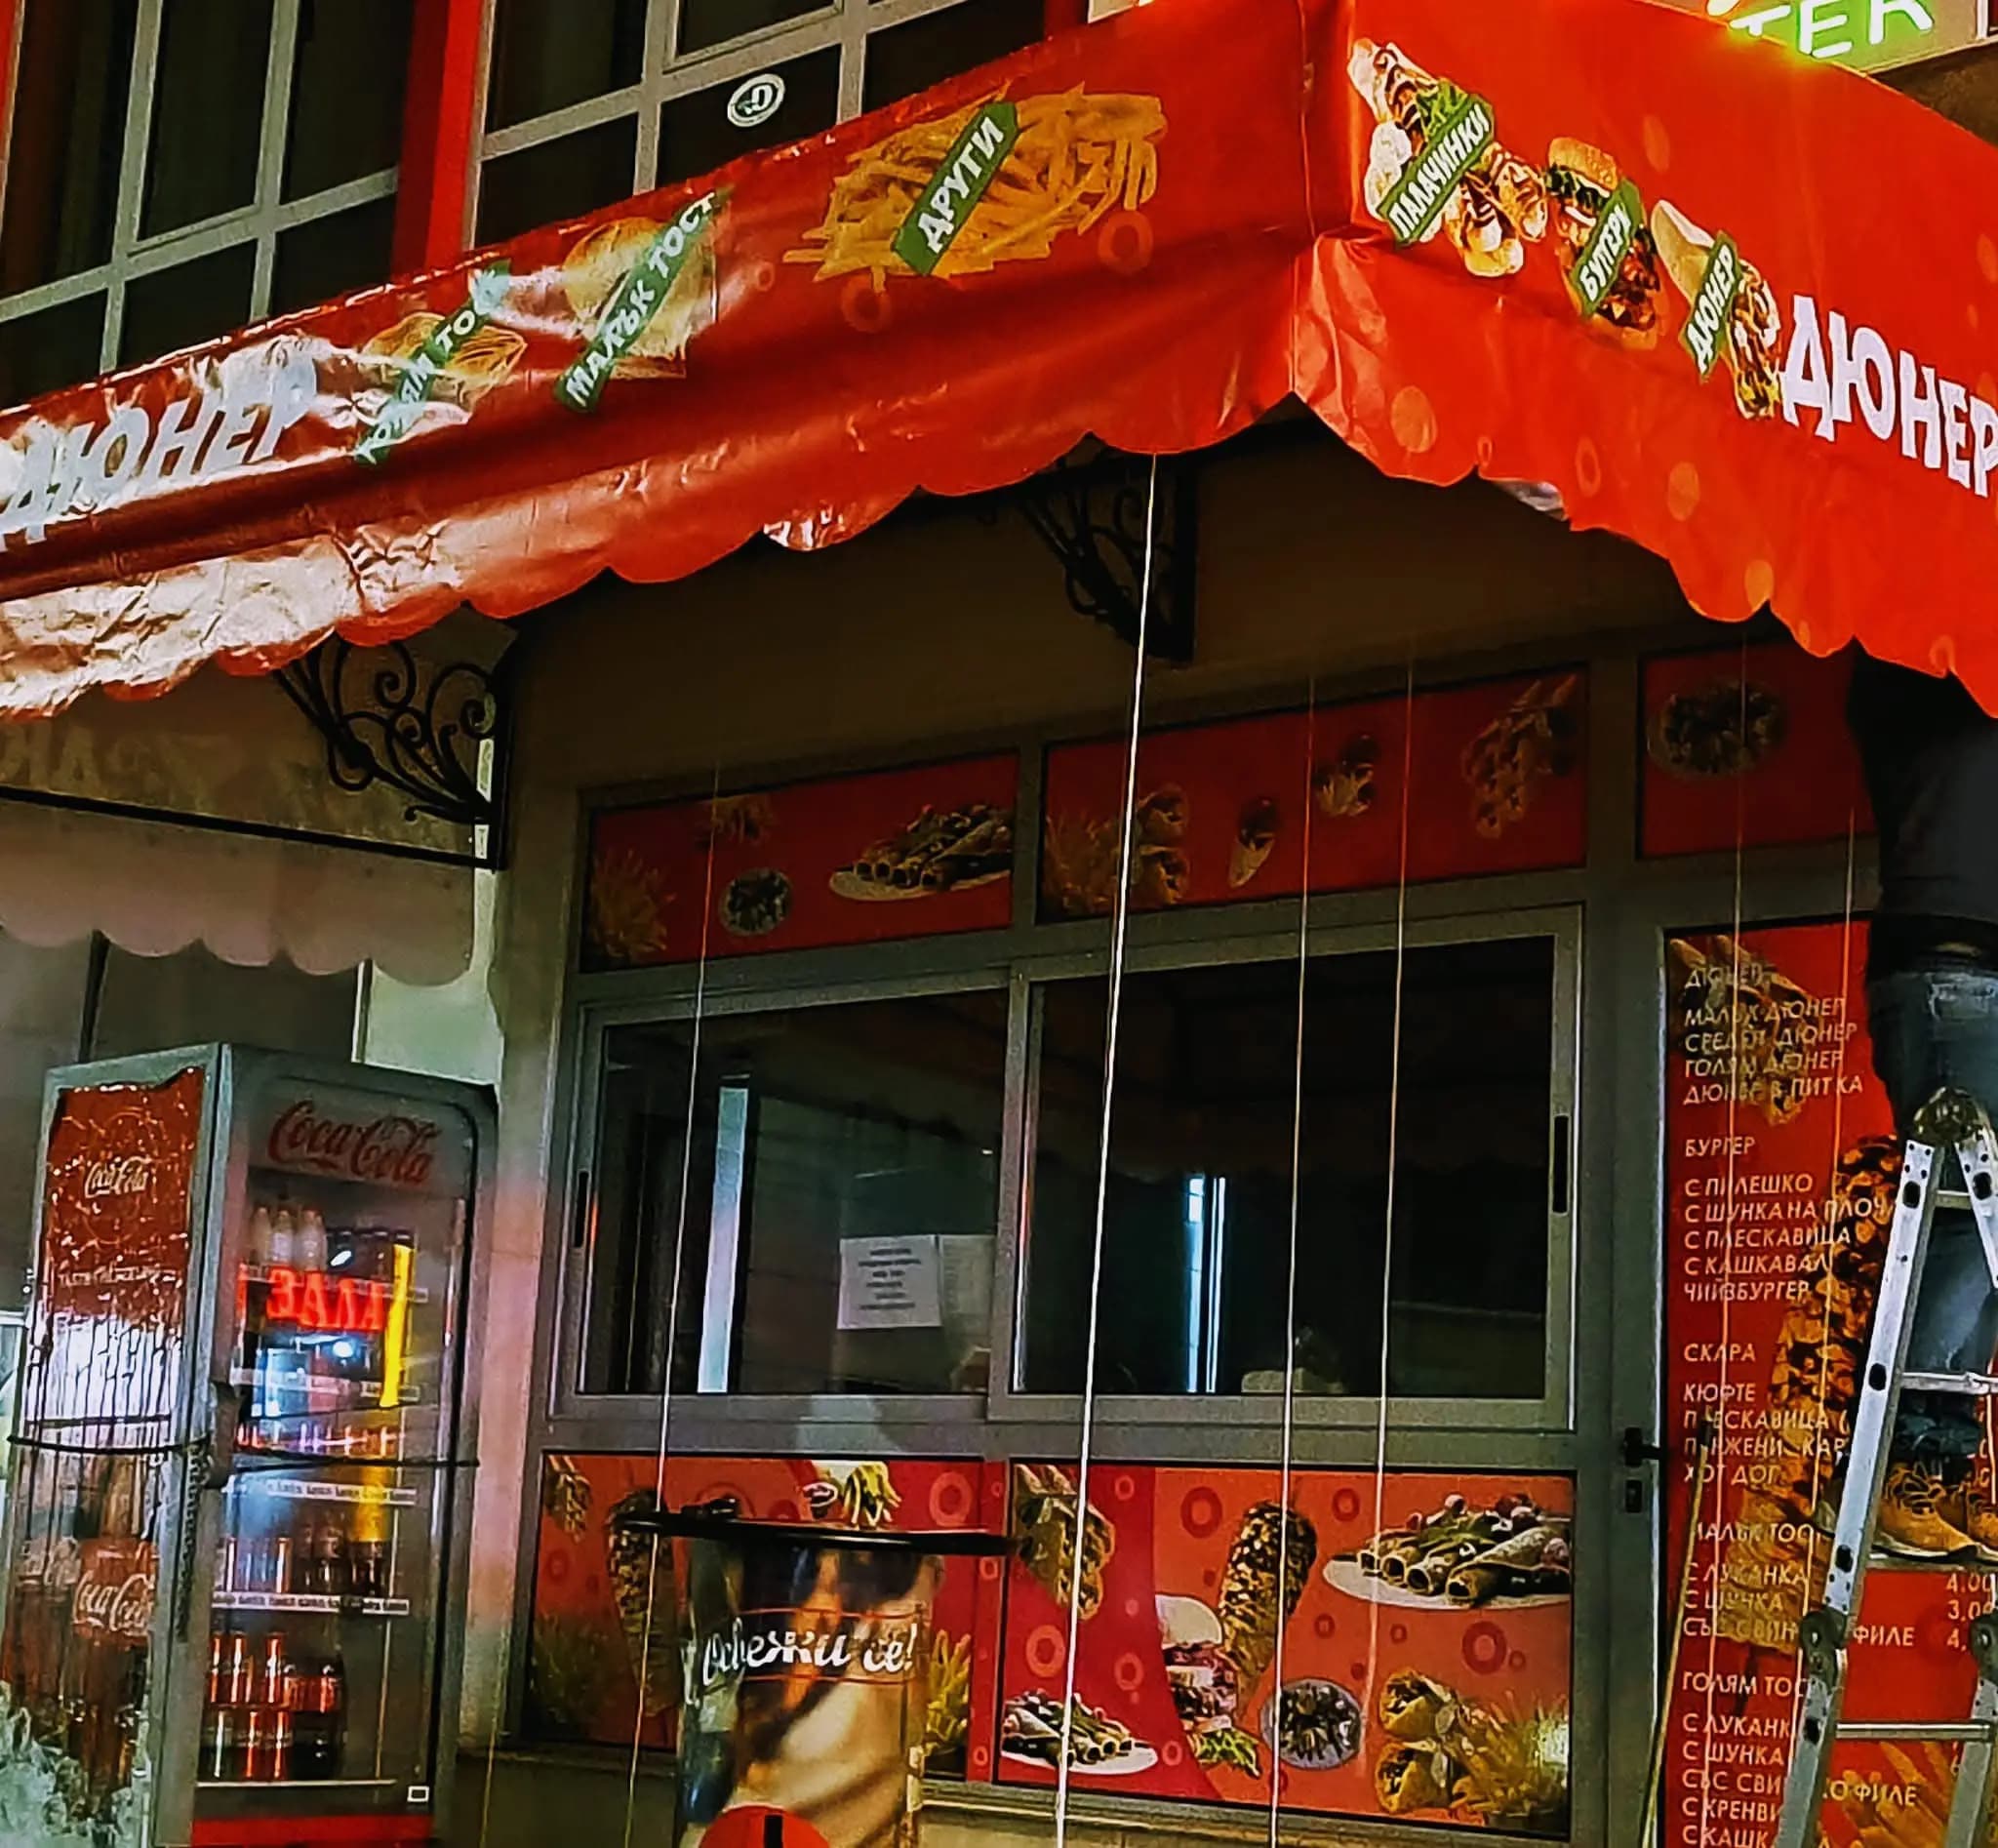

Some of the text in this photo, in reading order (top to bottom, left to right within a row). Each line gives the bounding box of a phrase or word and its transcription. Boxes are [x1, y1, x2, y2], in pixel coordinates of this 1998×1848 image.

[1389, 103, 1490, 239] ПАЛАЧИНКИ
[917, 116, 1005, 254] ДРУГИ
[648, 191, 716, 279] ТОСТ
[1687, 244, 1735, 376] ДЮНЕР
[1778, 295, 1998, 499] ДЮНЕР
[1685, 1136, 1755, 1157] БУРГЕР
[1685, 1178, 1700, 1197] С
[1685, 1204, 1699, 1223] С
[1704, 1199, 1782, 1223] ШУНКА
[1786, 1199, 1817, 1220] НА
[1684, 1230, 1699, 1250] С
[1684, 1257, 1699, 1276] С
[1684, 1343, 1756, 1362] СКАРА
[1683, 1384, 1756, 1402] КЮФТЕ
[1853, 1626, 1915, 1647] ФИЛЕ
[1683, 1671, 1757, 1696] ГОЛЯМ
[1683, 1713, 1699, 1732] С
[1683, 1741, 1784, 1765] С ШУНКА
[1682, 1797, 1698, 1816] С
[1682, 1826, 1698, 1844] С
